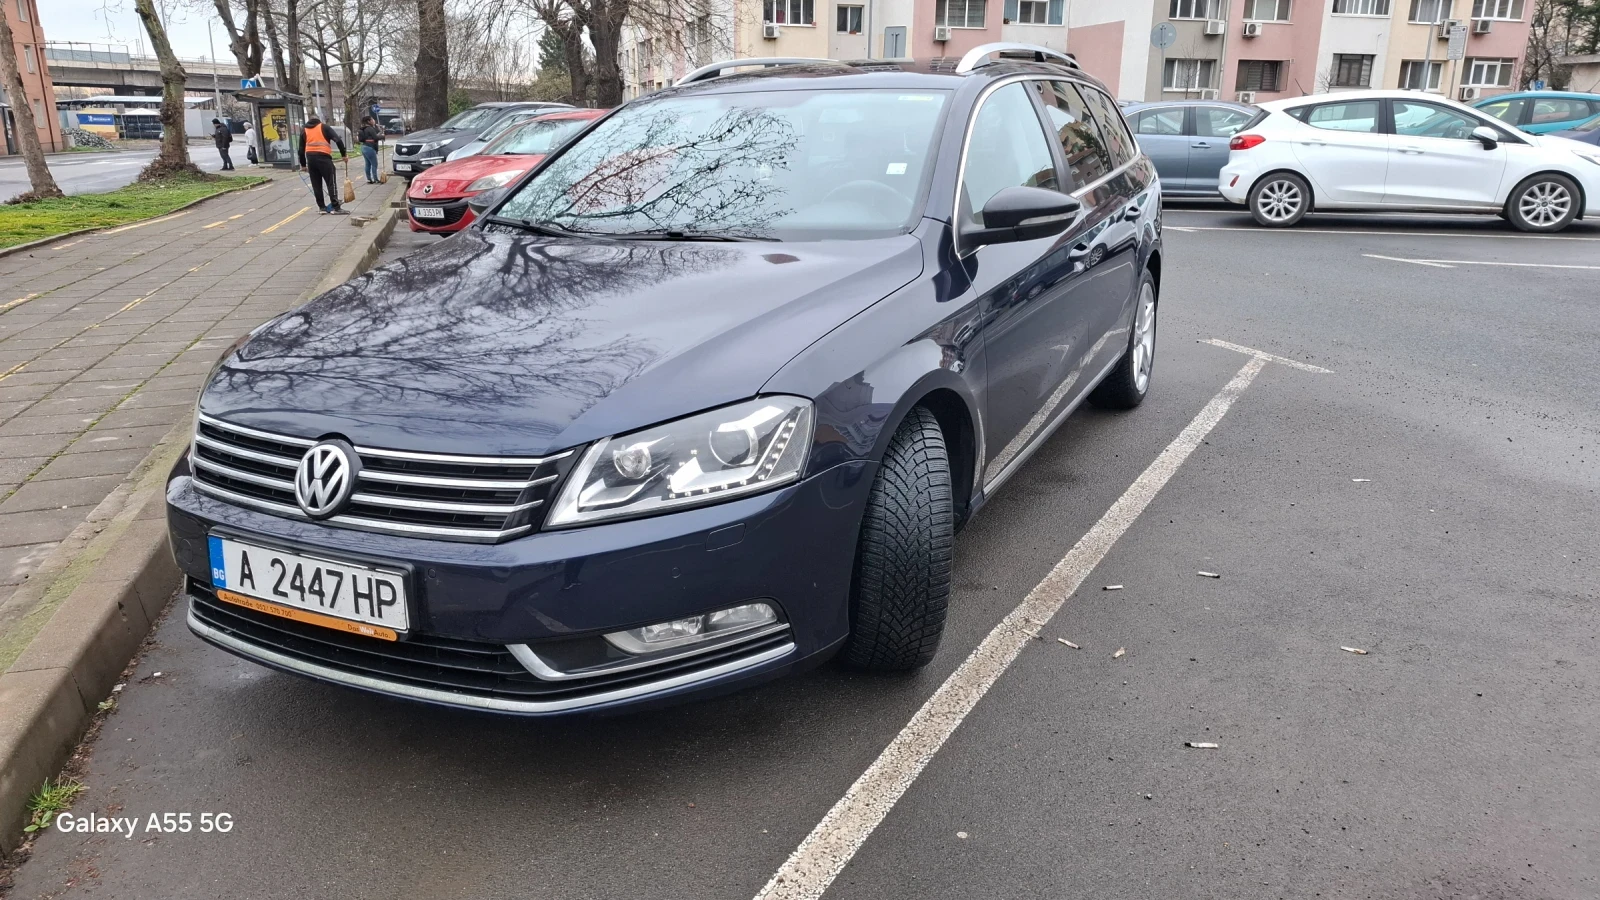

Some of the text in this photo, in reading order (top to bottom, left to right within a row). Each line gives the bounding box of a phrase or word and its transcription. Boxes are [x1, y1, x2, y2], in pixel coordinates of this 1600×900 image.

[295, 444, 350, 515] VW
[213, 567, 225, 581] BG
[239, 550, 397, 619] A 2447 HP
[223, 593, 253, 608] Autotrade
